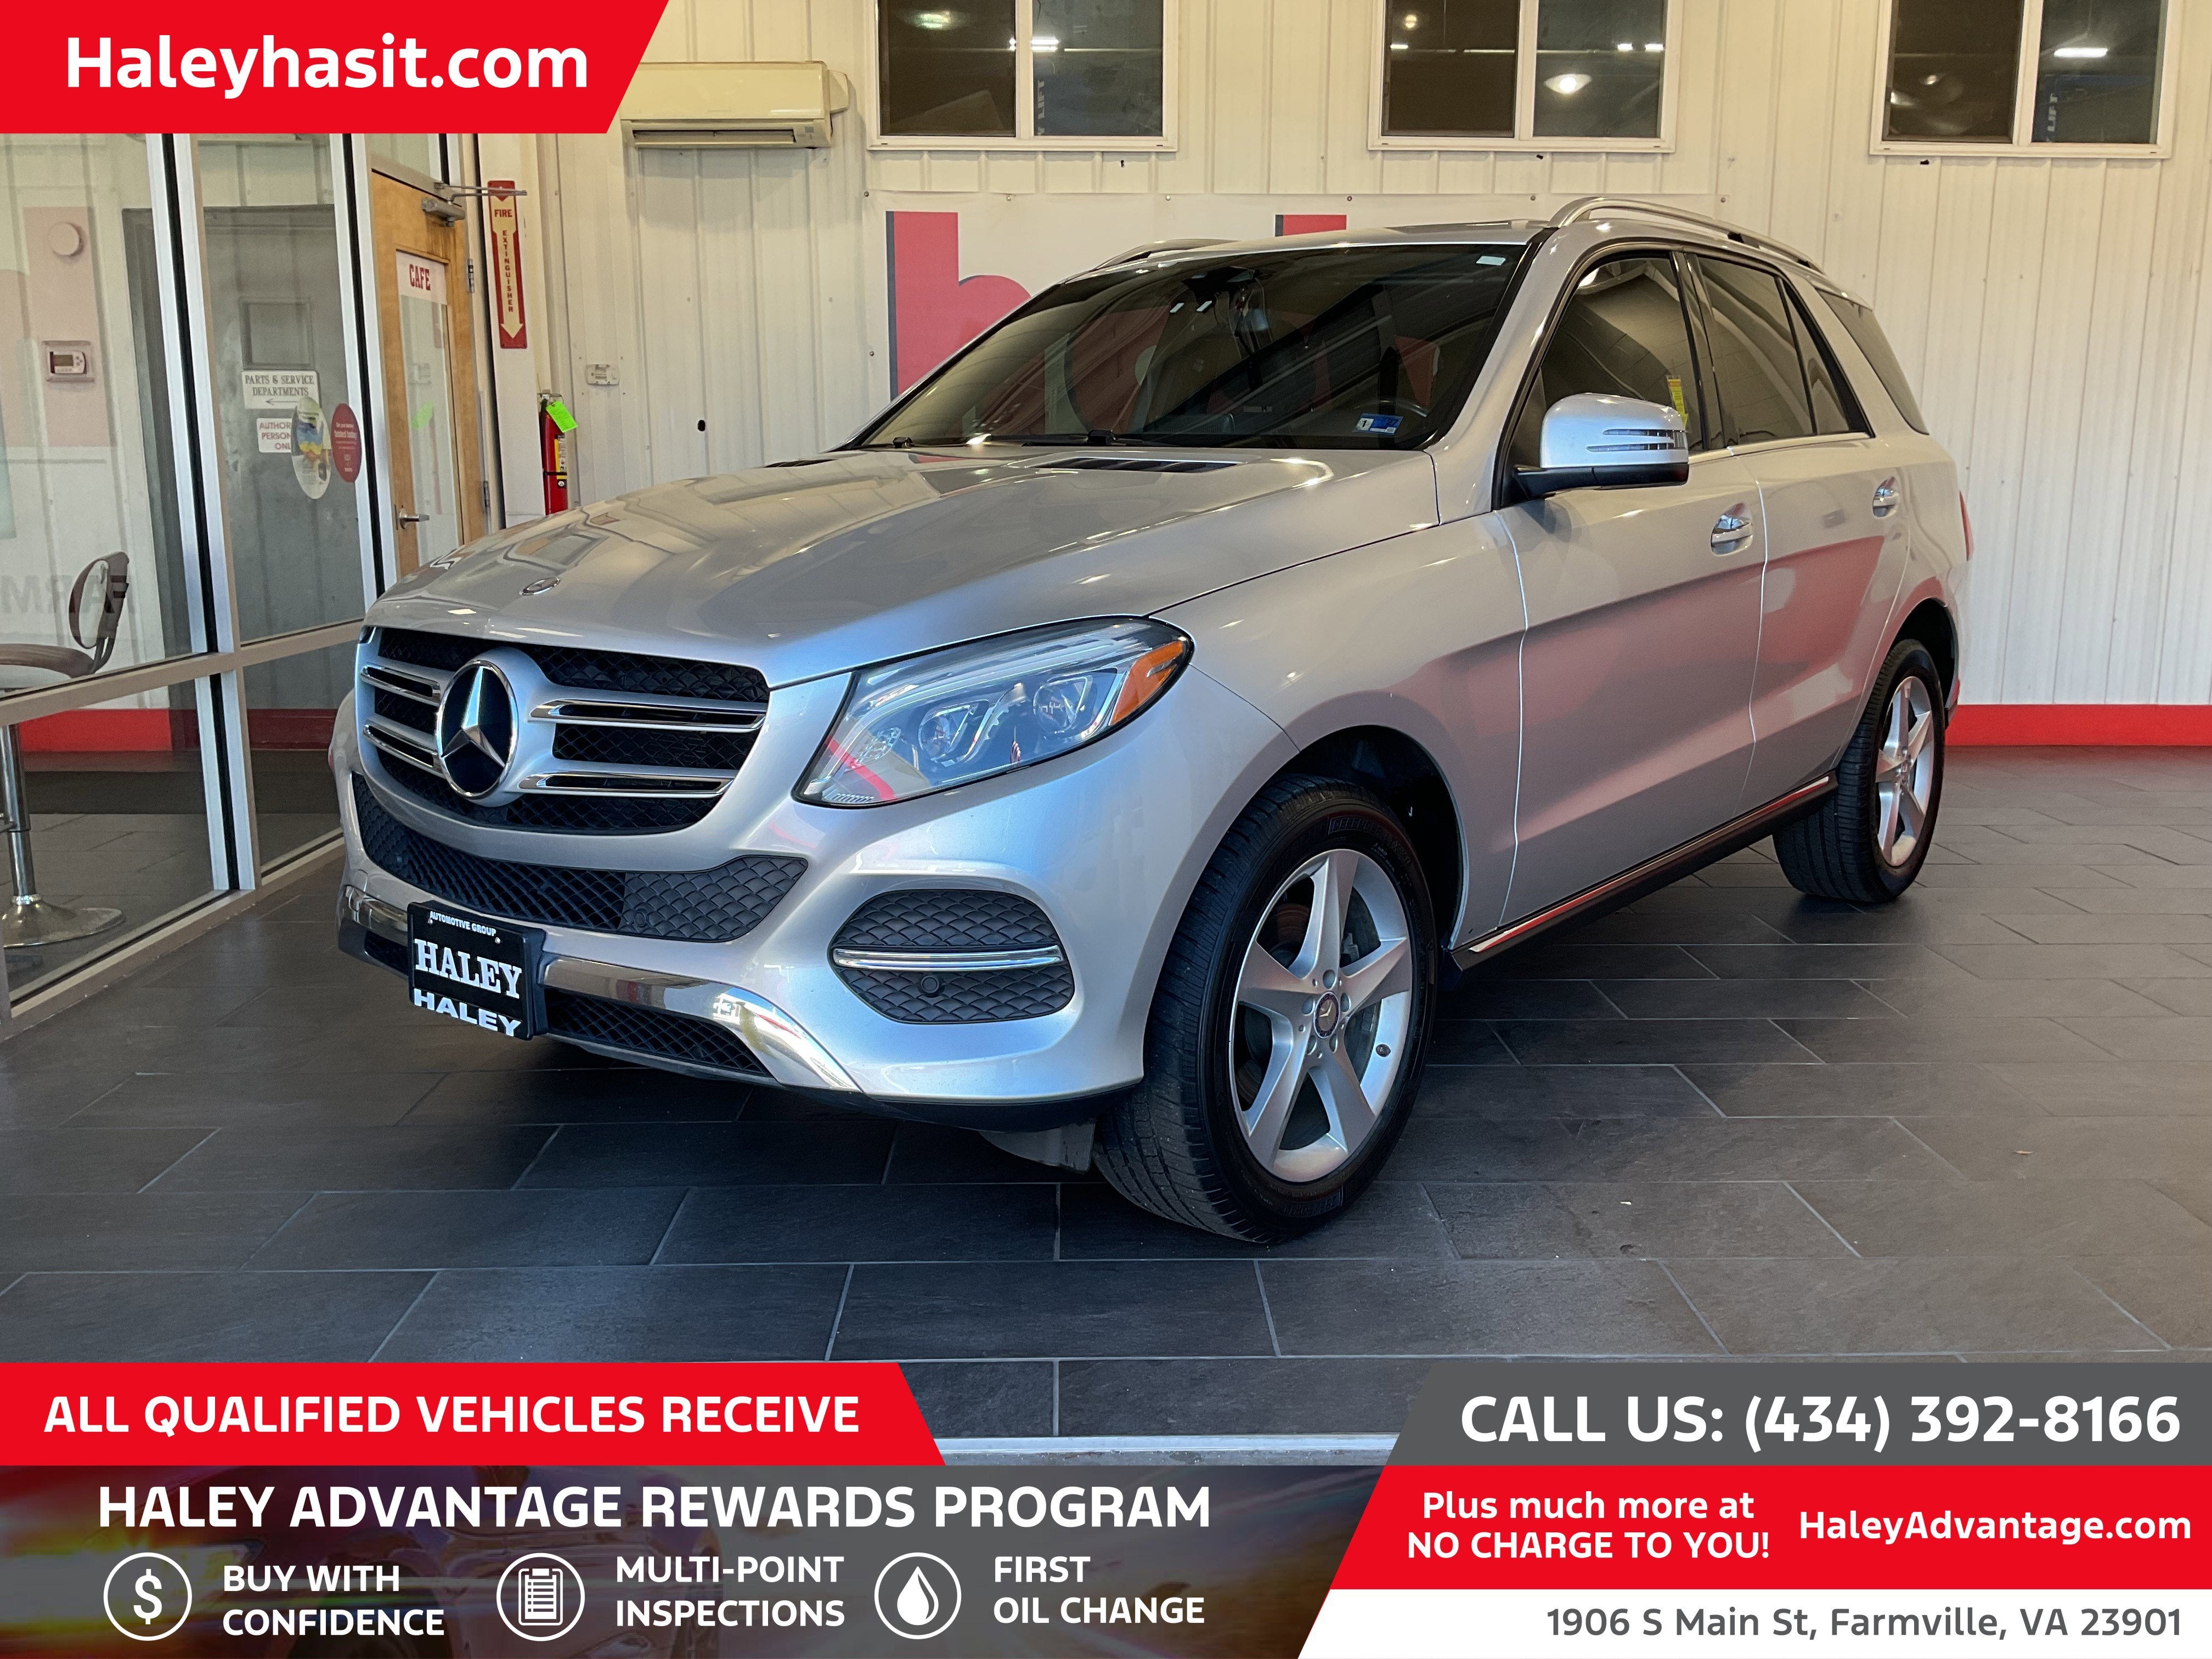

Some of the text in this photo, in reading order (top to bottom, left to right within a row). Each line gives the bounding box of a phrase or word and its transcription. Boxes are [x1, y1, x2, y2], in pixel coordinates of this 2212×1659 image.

[494, 209, 512, 218] FIRE
[409, 264, 431, 291] CAFE
[503, 230, 514, 312] EXTINGUISHER
[245, 375, 314, 384] PARTS & SERVICE
[253, 387, 309, 396] DEPARTMENTS
[430, 911, 496, 936] AUTOMOTIVE GROUP
[414, 938, 522, 999] HALEY
[414, 988, 521, 1037] HALEY
